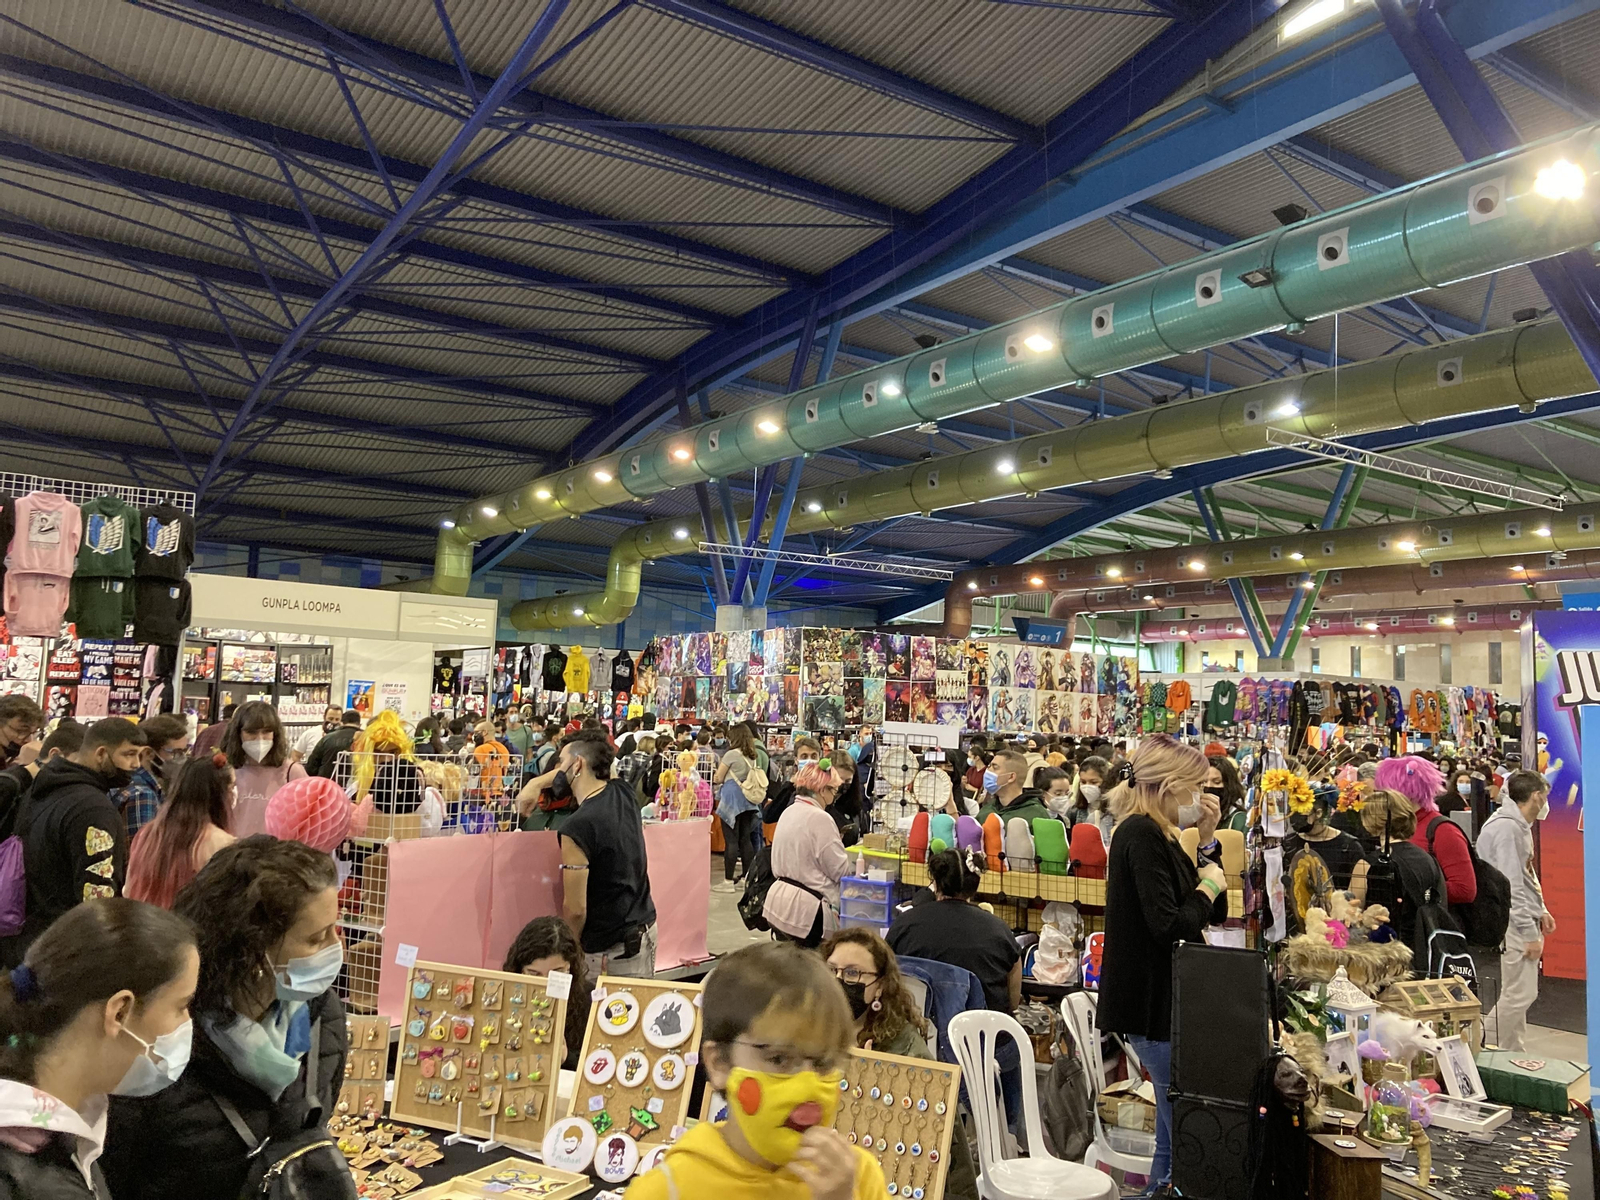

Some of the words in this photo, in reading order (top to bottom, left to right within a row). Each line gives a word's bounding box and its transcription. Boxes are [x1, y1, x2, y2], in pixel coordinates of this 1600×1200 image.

[261, 596, 300, 611] GUNPLA
[302, 599, 342, 614] LOOMPA
[1055, 630, 1062, 643] 1
[83, 655, 94, 663] MY
[95, 656, 113, 664] GAME
[114, 655, 132, 664] MAKE
[114, 679, 139, 687] VIOLENT
[555, 1154, 581, 1164] Michael
[604, 1167, 625, 1175] BOWIE
